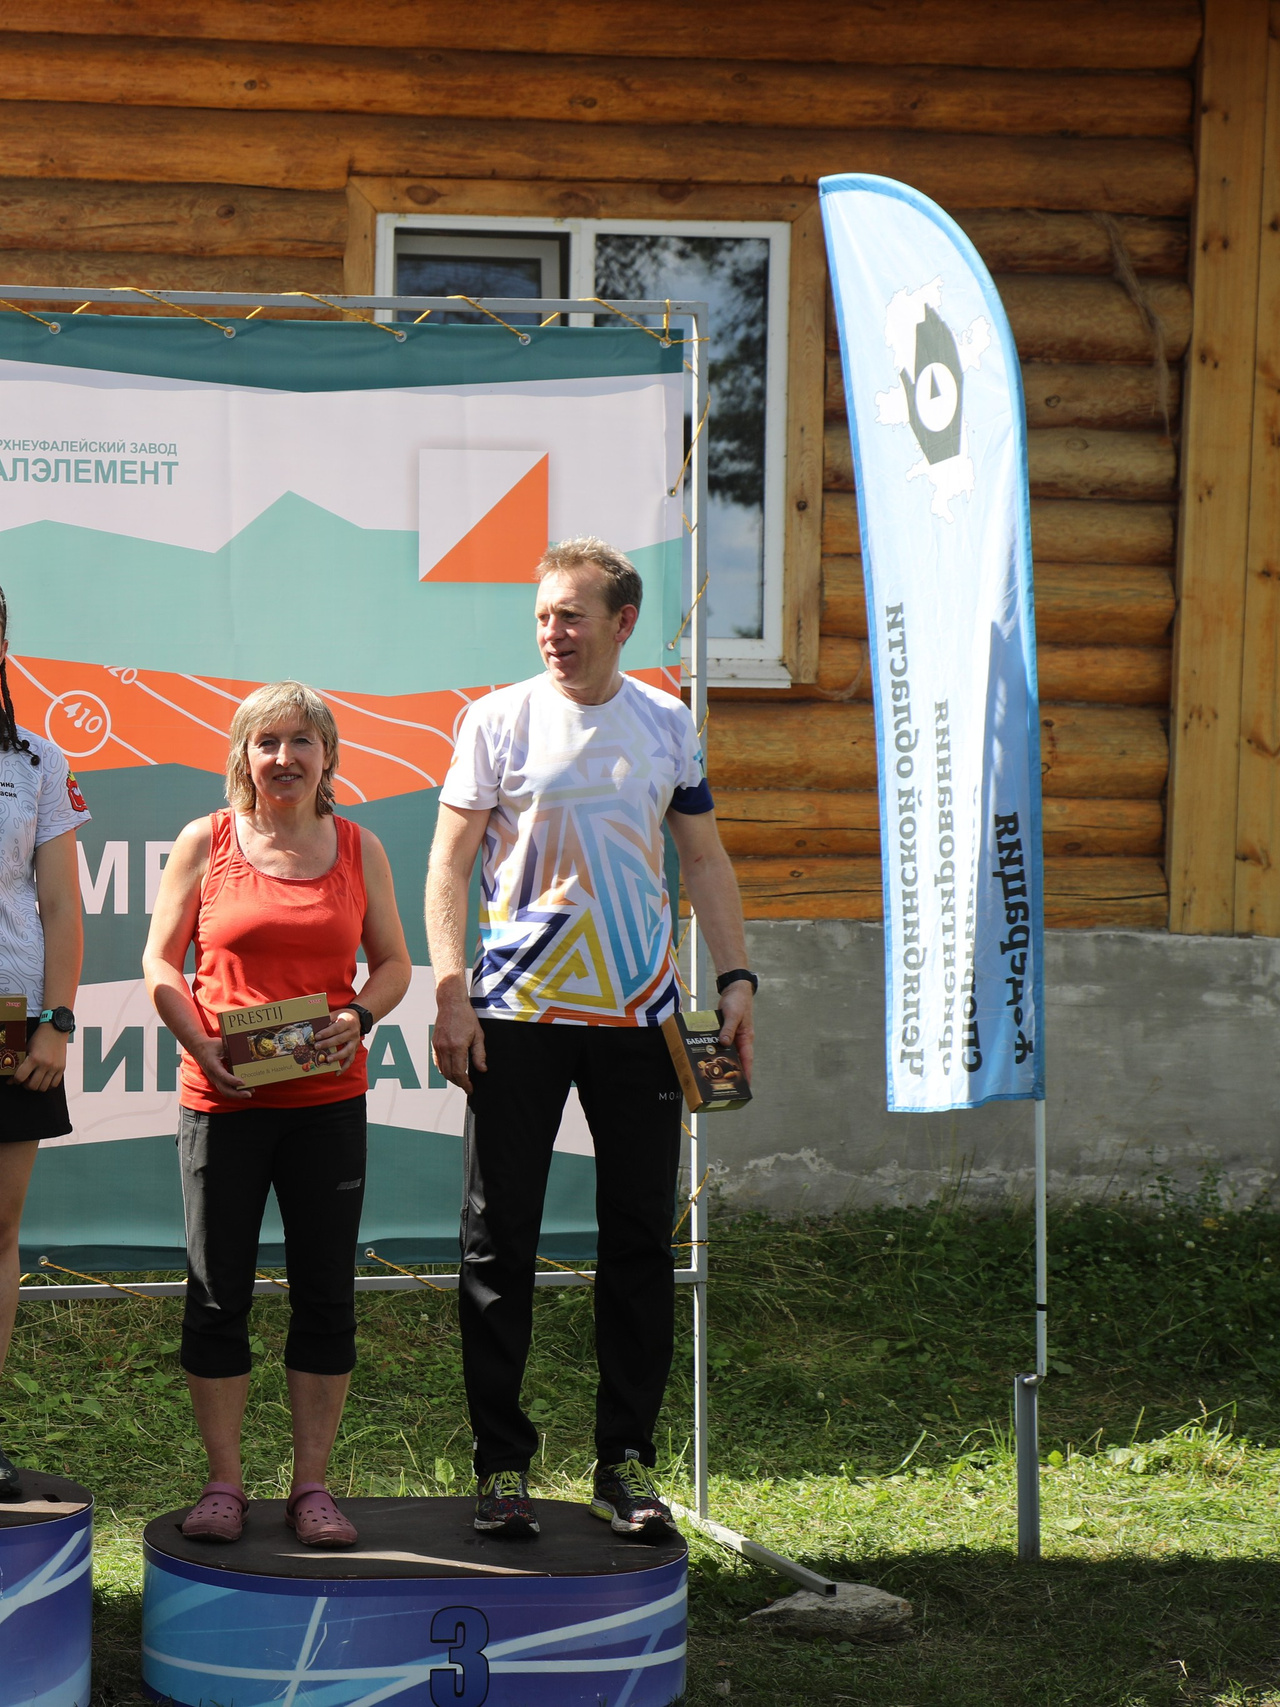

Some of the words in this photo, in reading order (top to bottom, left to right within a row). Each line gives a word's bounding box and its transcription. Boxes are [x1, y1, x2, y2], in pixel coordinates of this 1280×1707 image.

[130, 442, 178, 457] ЗАВОД
[228, 1006, 283, 1028] PRESTIJ
[429, 1605, 489, 1707] 3
